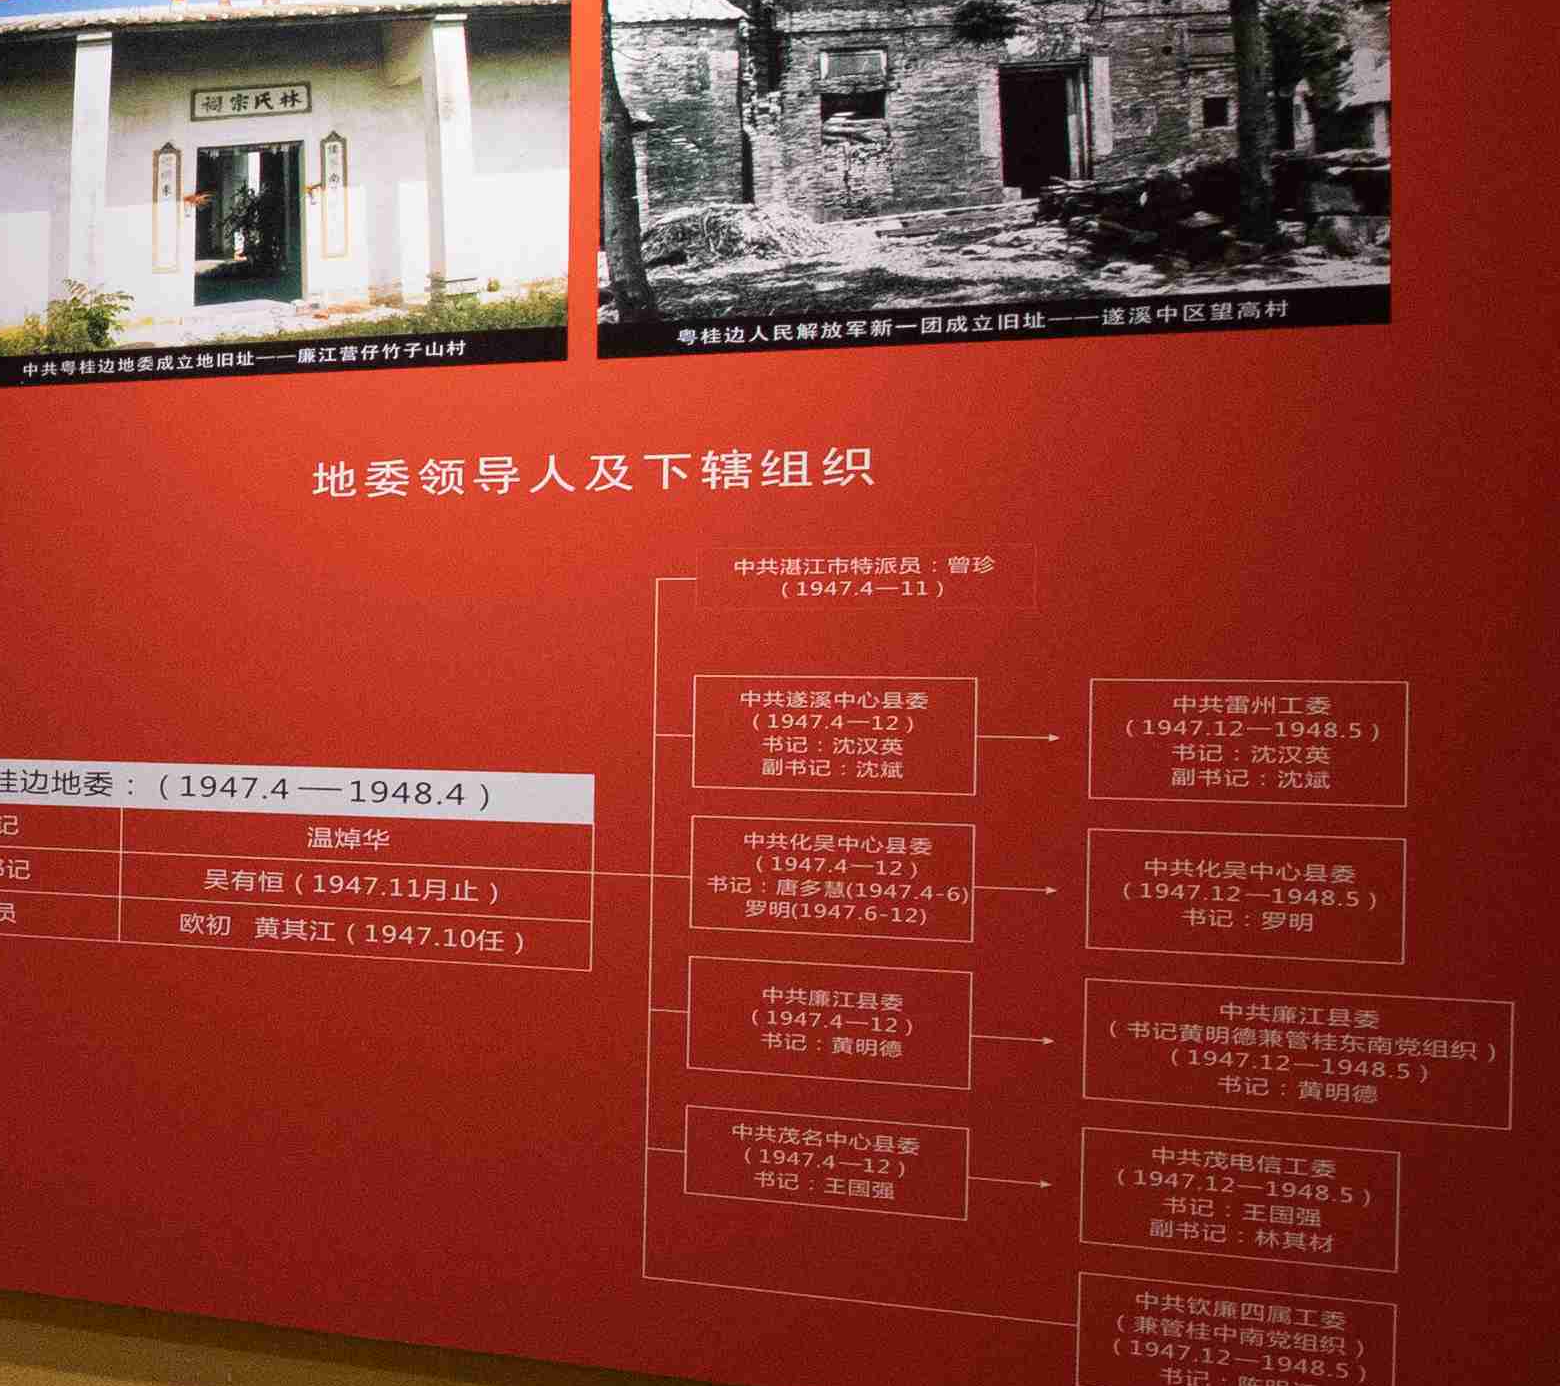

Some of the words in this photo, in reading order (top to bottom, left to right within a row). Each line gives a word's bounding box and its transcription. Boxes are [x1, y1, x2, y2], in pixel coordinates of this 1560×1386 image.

[676, 299, 1289, 346] 粤桂边人民解放军新一团成立旧址——遂溪中区望高村
[22, 340, 466, 377] 中共粤桂边地委成立地旧址——廉江营仔竹子山村
[311, 447, 875, 499] 地委领导人及下辖组织
[734, 556, 995, 575] 中共湛江市特派员：曾珍
[740, 691, 929, 710] 中共遂溪中心县委
[1172, 695, 1332, 715] 中共雷州工委
[744, 831, 932, 855] 中共化吴中心县委
[179, 912, 231, 936] 欧初
[762, 986, 905, 1012] 中共廉江县委
